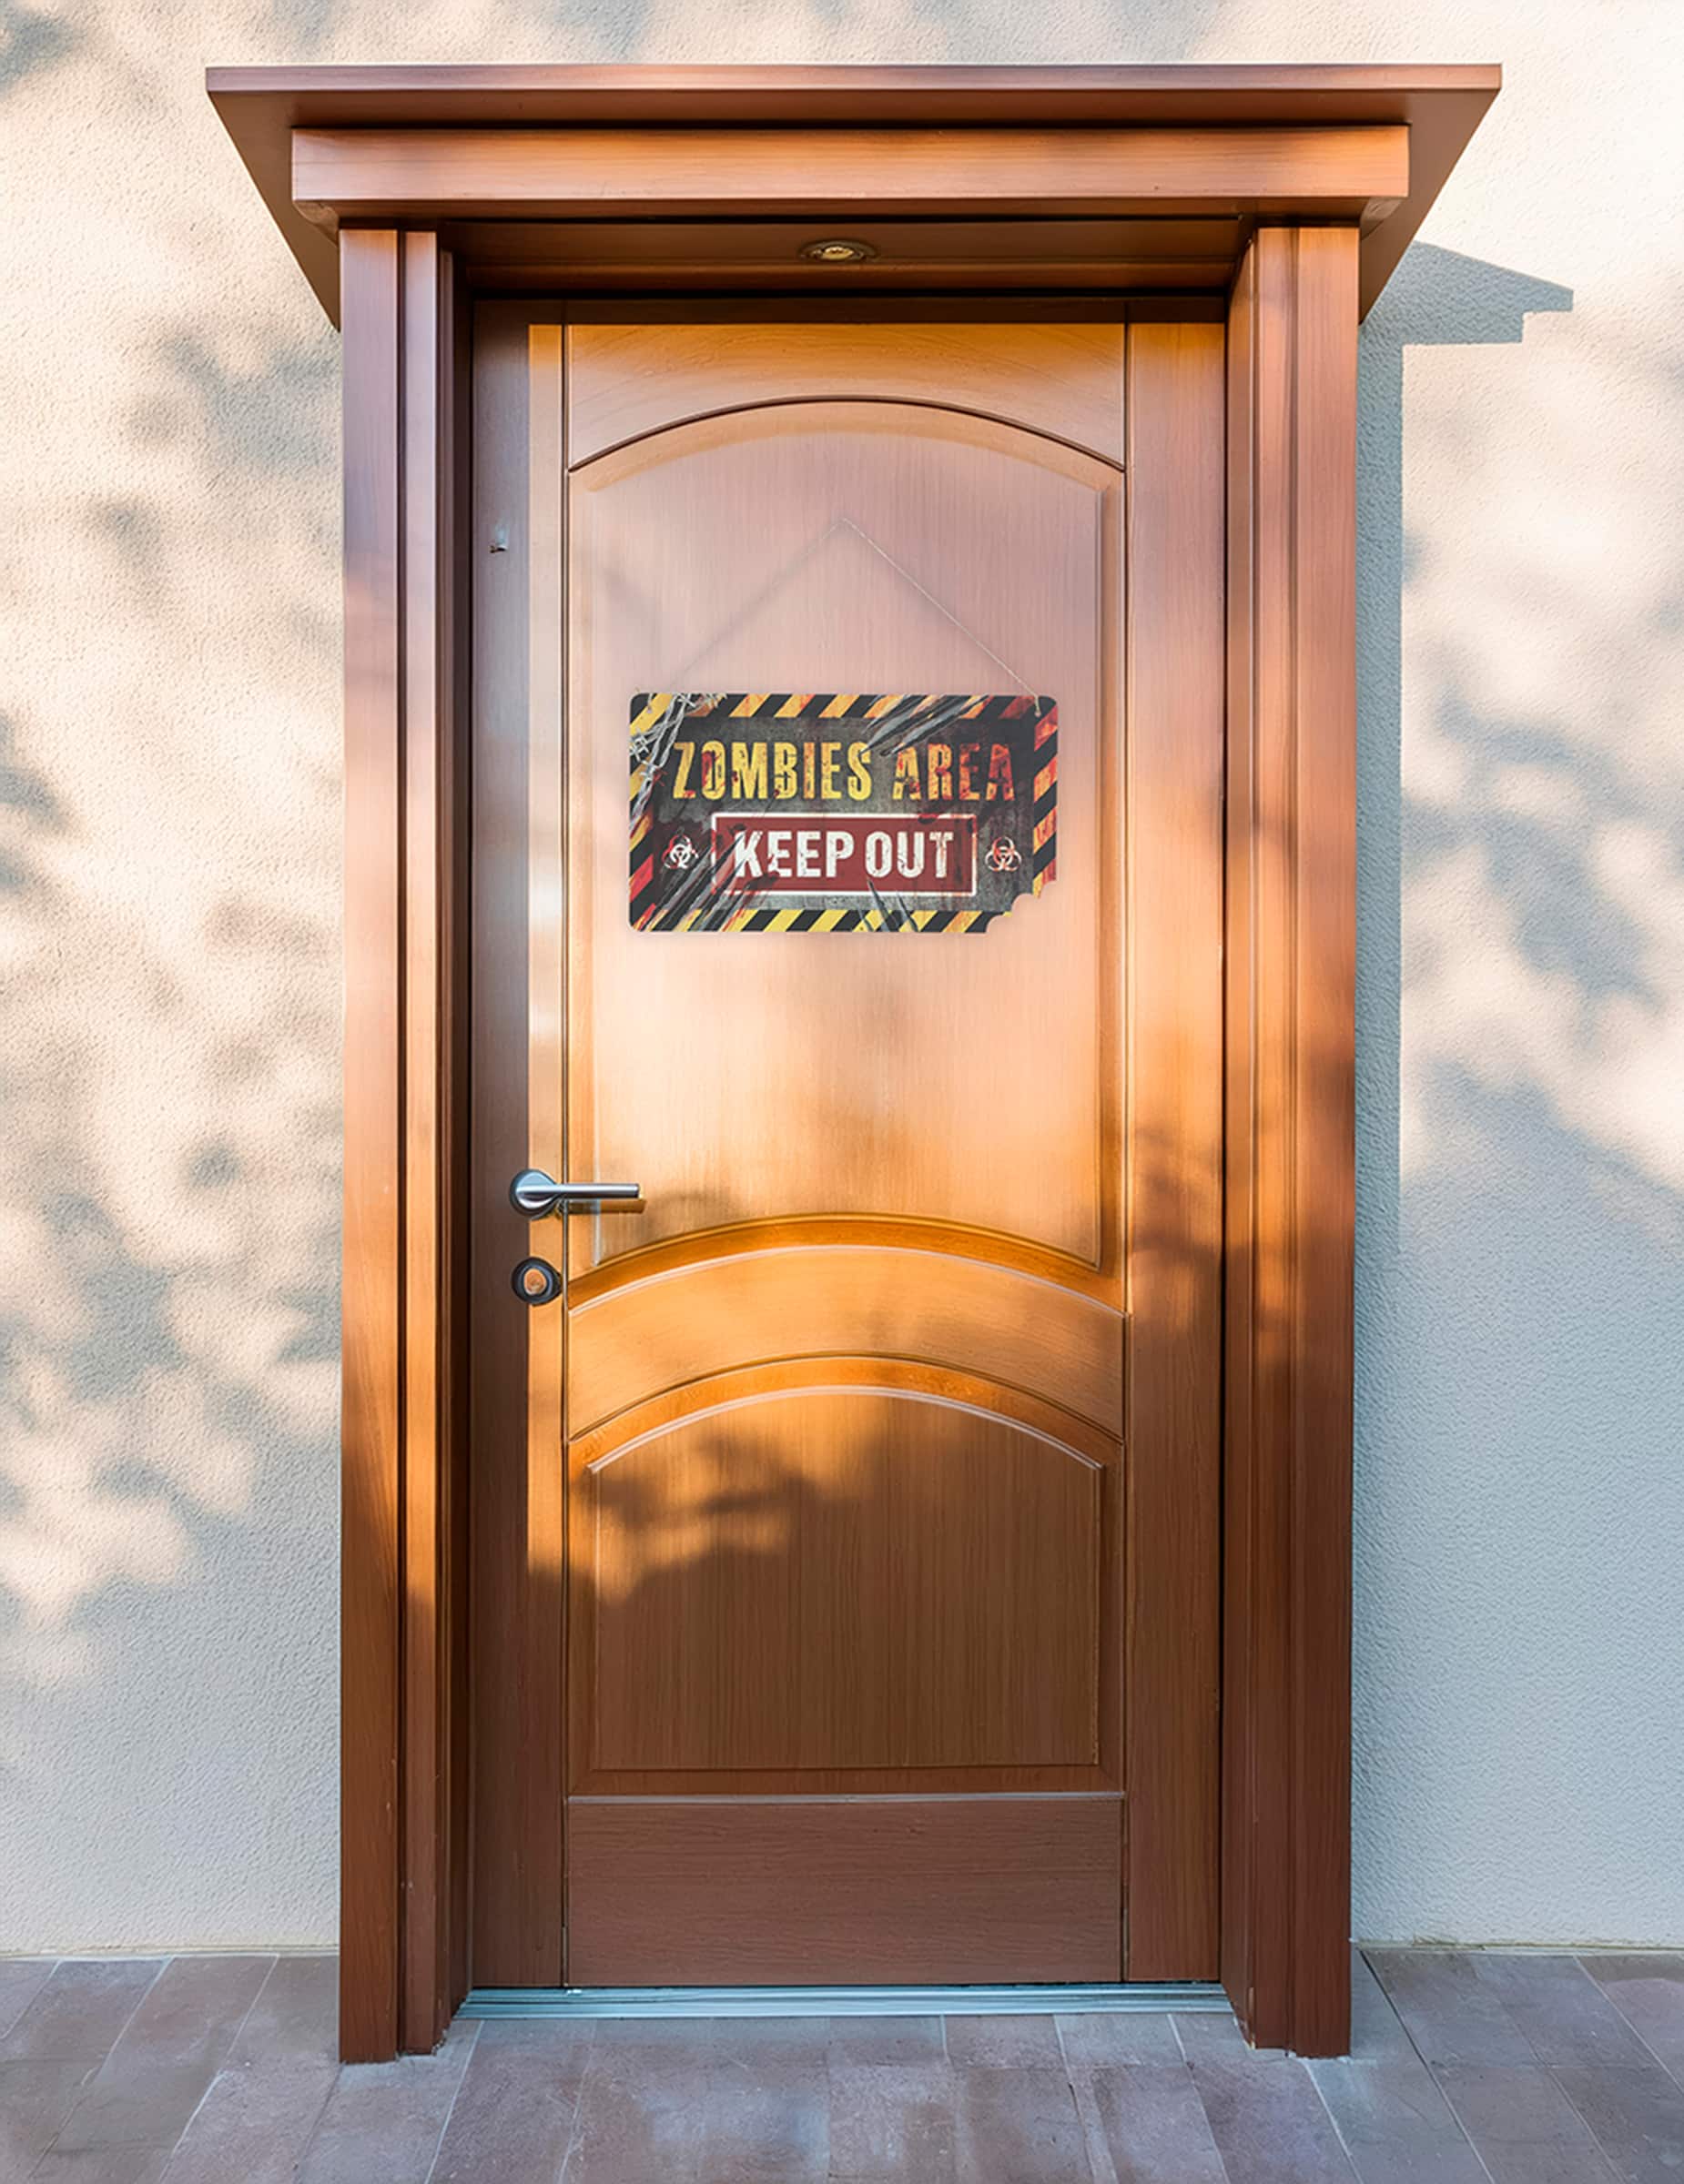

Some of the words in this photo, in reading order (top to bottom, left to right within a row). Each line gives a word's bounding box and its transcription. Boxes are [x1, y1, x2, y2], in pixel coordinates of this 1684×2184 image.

[673, 740, 871, 801] ZOMBIES
[892, 742, 1015, 802] AREA
[735, 830, 855, 878] KEEP
[865, 830, 954, 878] OUT
